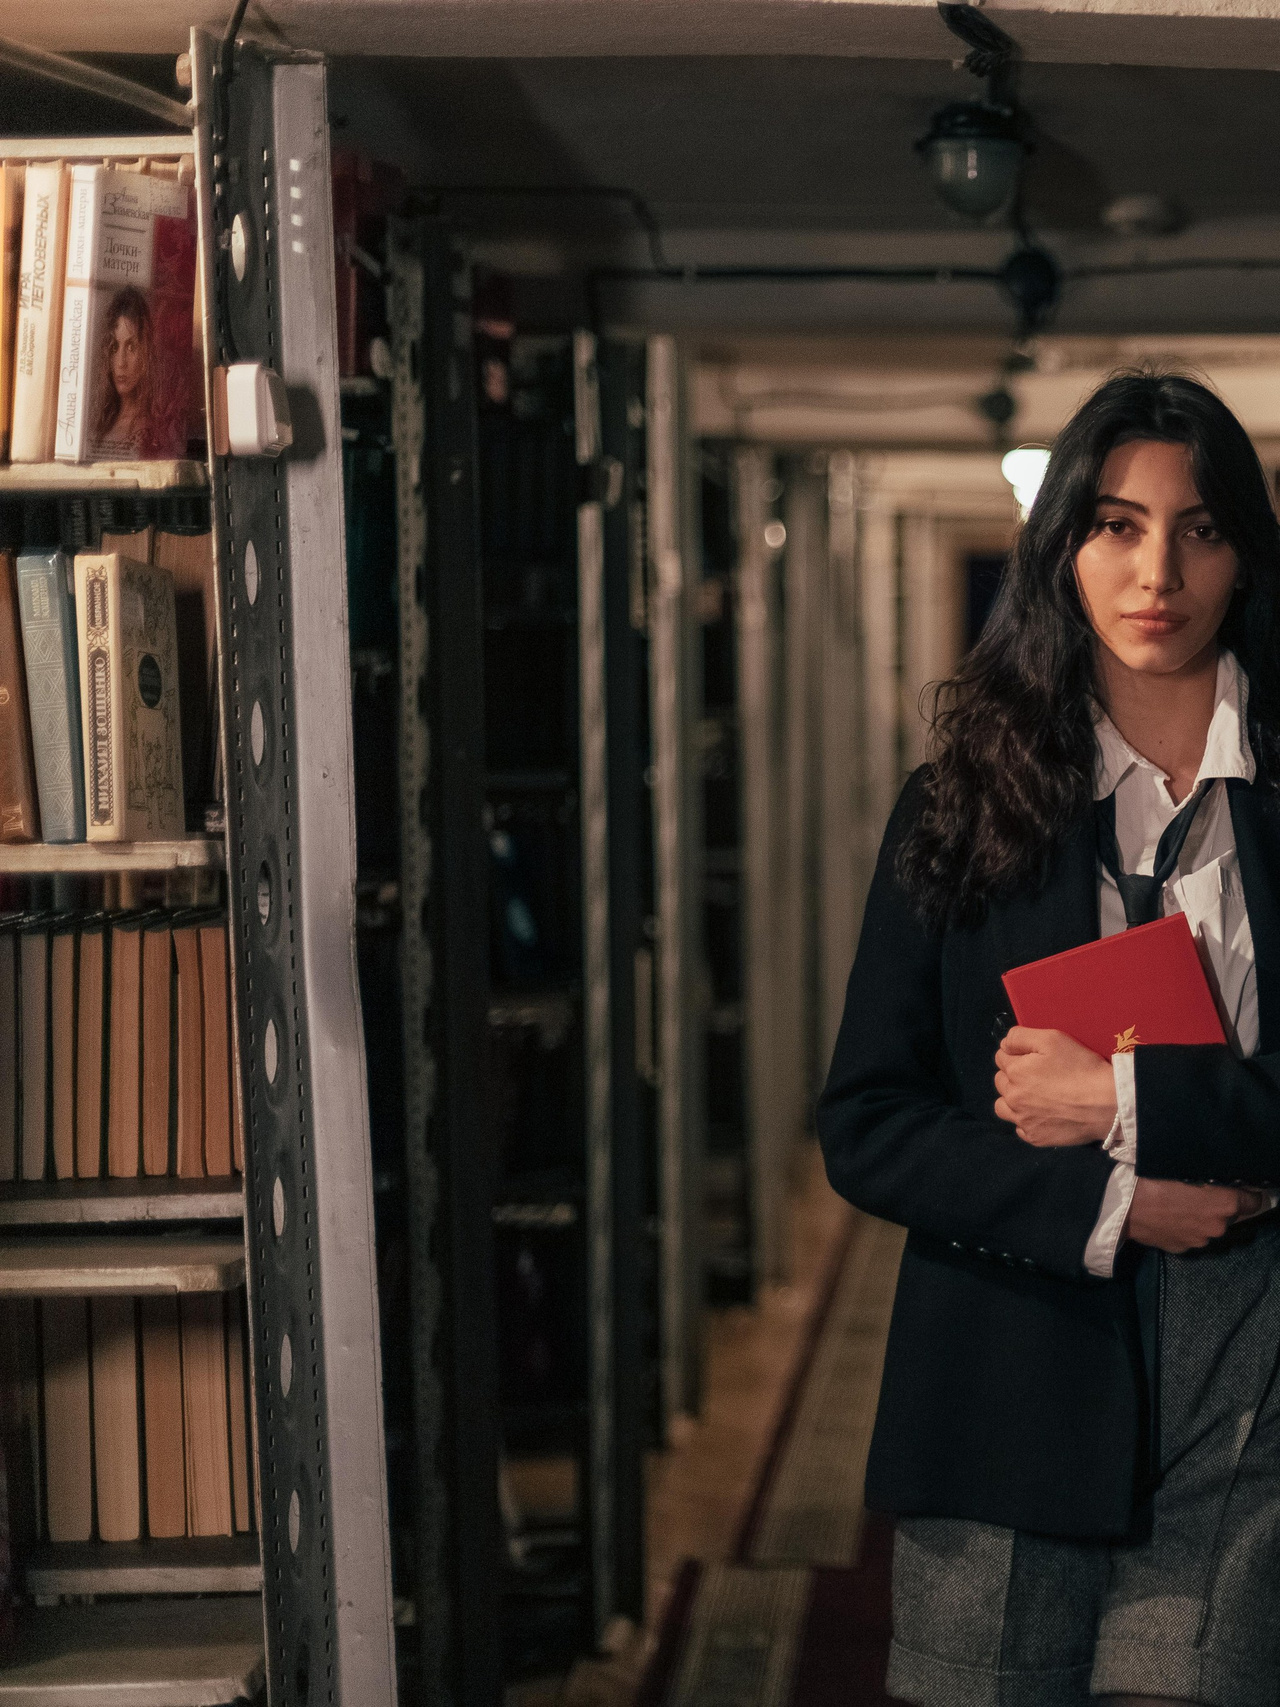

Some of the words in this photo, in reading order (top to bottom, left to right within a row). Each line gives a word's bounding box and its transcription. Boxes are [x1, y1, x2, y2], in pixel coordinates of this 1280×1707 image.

[31, 194, 50, 312] ЛЕГКОВЕРНЫХ
[102, 256, 141, 277] матери
[103, 236, 142, 258] Дочки-
[19, 272, 32, 311] ИГРА
[63, 299, 84, 388] Знаменская
[58, 393, 80, 447] Алина
[92, 581, 104, 628] ИЗБРАННОЕ
[96, 738, 112, 812] МИХАИЛ
